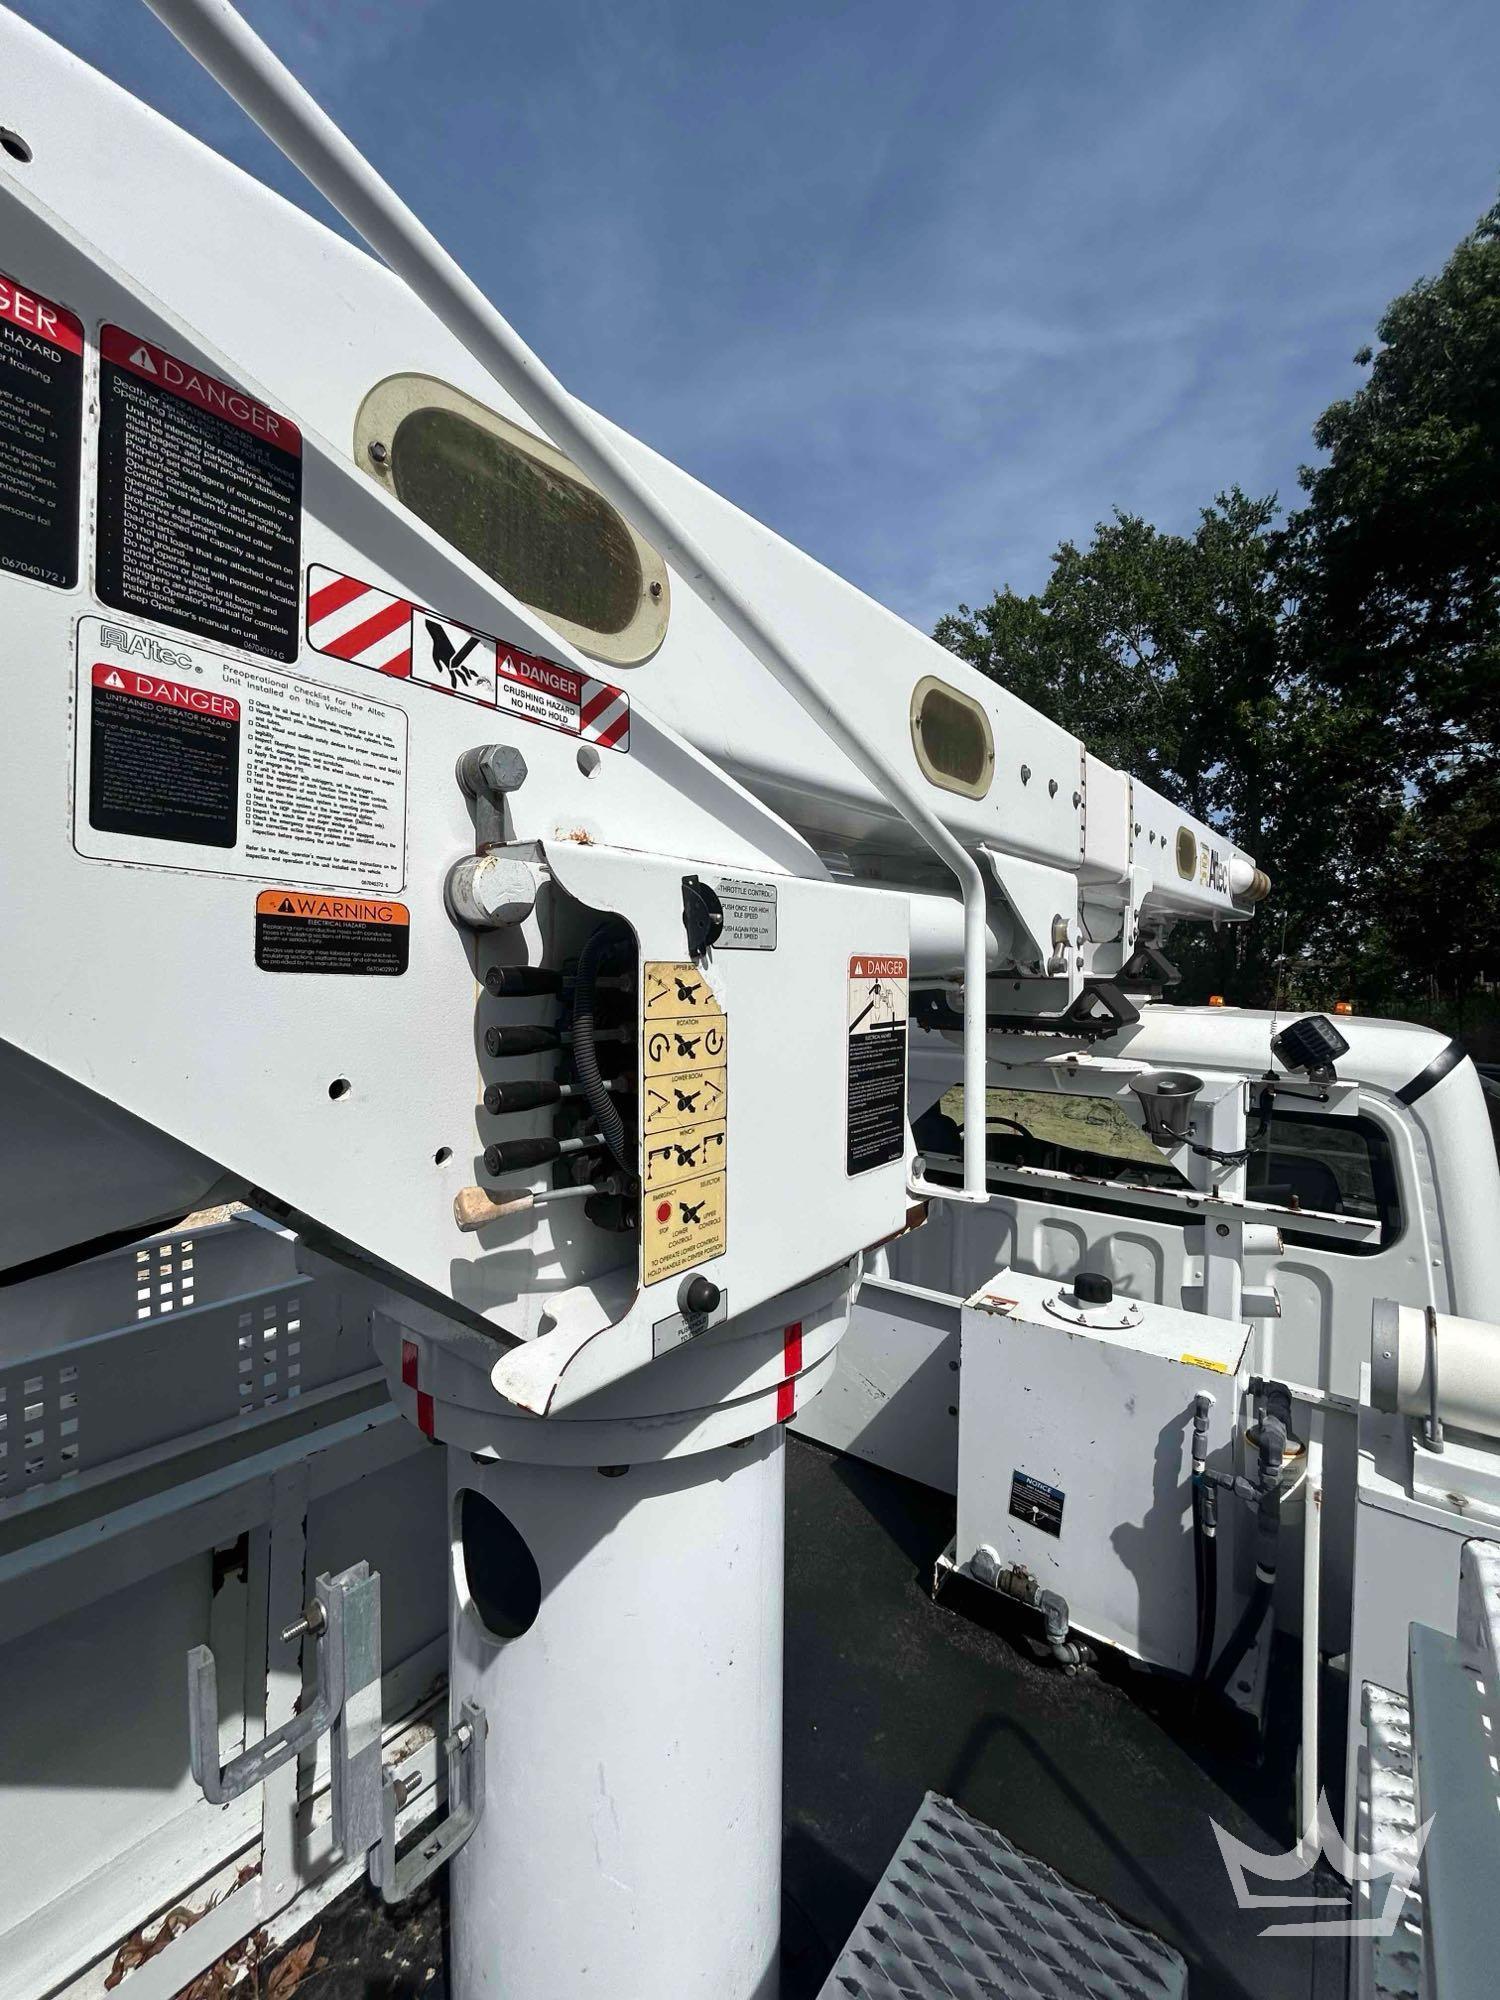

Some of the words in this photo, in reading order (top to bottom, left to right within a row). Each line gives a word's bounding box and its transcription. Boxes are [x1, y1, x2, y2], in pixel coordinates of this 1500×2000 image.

[4, 324, 61, 366] HAZARD
[164, 358, 279, 439] DANGER
[124, 491, 169, 518] protective
[124, 509, 143, 524] load
[124, 483, 143, 497] Use
[146, 493, 175, 512] proper
[178, 505, 190, 517] fall
[192, 511, 233, 537] protection
[235, 530, 251, 542] and
[252, 537, 272, 551] other
[124, 527, 133, 537] to
[136, 532, 150, 544] the
[124, 500, 138, 513] Do
[140, 507, 154, 519] not
[157, 514, 189, 534] exceed
[191, 528, 207, 541] unit
[209, 535, 243, 557] capacity
[245, 551, 255, 560] as
[257, 554, 281, 571] shown
[283, 566, 293, 575] on
[123, 544, 150, 562] under
[153, 555, 178, 572] boom
[180, 567, 189, 576] or
[123, 535, 137, 548] Do
[139, 542, 154, 554] not
[156, 549, 190, 569] operate
[192, 561, 208, 574] unit
[210, 568, 227, 582] with
[229, 575, 268, 598] personnel
[270, 591, 296, 607] located
[124, 518, 137, 530] Do
[140, 524, 154, 537] not
[157, 531, 167, 542] lift
[170, 536, 193, 552] loads
[195, 546, 212, 559] that
[214, 556, 227, 565] are
[230, 559, 263, 579] attached
[265, 575, 273, 583] or
[275, 577, 294, 591] stuck
[123, 562, 169, 587] outriggers
[172, 581, 186, 592] are
[188, 586, 222, 606] properly
[123, 553, 137, 566] Do
[139, 559, 153, 571] not
[156, 567, 181, 581] move
[183, 575, 213, 593] vehicle
[215, 586, 232, 599] until
[234, 593, 260, 610] booms
[262, 603, 277, 616] and
[122, 570, 149, 587] Refer
[151, 581, 160, 591] to
[162, 584, 207, 609] Operator's
[209, 601, 239, 618] manual
[241, 612, 251, 622] for
[254, 617, 288, 636] complete
[123, 589, 148, 606] Keep
[150, 597, 196, 622] Operator's
[198, 614, 228, 631] manual
[231, 626, 241, 635] on
[223, 664, 289, 690] Preoperational
[294, 685, 330, 701] Checklist
[335, 697, 346, 707] for
[352, 701, 363, 711] the
[367, 707, 386, 718] Altec
[520, 660, 576, 696] DANGER
[106, 693, 154, 711] UNTRAINED
[156, 705, 198, 722] OPERATOR
[201, 717, 232, 729] HAZARD
[136, 677, 235, 716] DANGER
[223, 676, 241, 685] Unit
[247, 682, 284, 698] Installed
[289, 694, 300, 702] on
[305, 697, 320, 708] this
[325, 704, 352, 717] Vehicle
[503, 683, 544, 705] CRUSHING
[546, 698, 575, 716] HAZARD
[511, 696, 523, 708] NO
[525, 701, 546, 716] HAND
[548, 710, 567, 723] HOLD
[297, 898, 392, 922] WARNING
[308, 919, 340, 927] ELECTRICAL
[343, 921, 366, 929] HAZARD
[867, 960, 903, 974] DANGER
[652, 1188, 676, 1201] EMERGENCY
[700, 1176, 720, 1187] SELECTOR
[672, 1226, 688, 1237] LOWER
[698, 1216, 721, 1230] CONTROLS
[651, 1258, 657, 1266] TO
[659, 1250, 679, 1264] OPERATE
[680, 1244, 695, 1255] LOWER
[696, 1235, 718, 1249] CONTROLS
[668, 1234, 692, 1248] CONTROLS
[648, 1267, 661, 1278] HOLD
[662, 1259, 680, 1272] HANDLE
[687, 1250, 702, 1261] CENTER
[704, 1242, 722, 1255] POSITION
[1026, 1478, 1052, 1493] NOTICE
